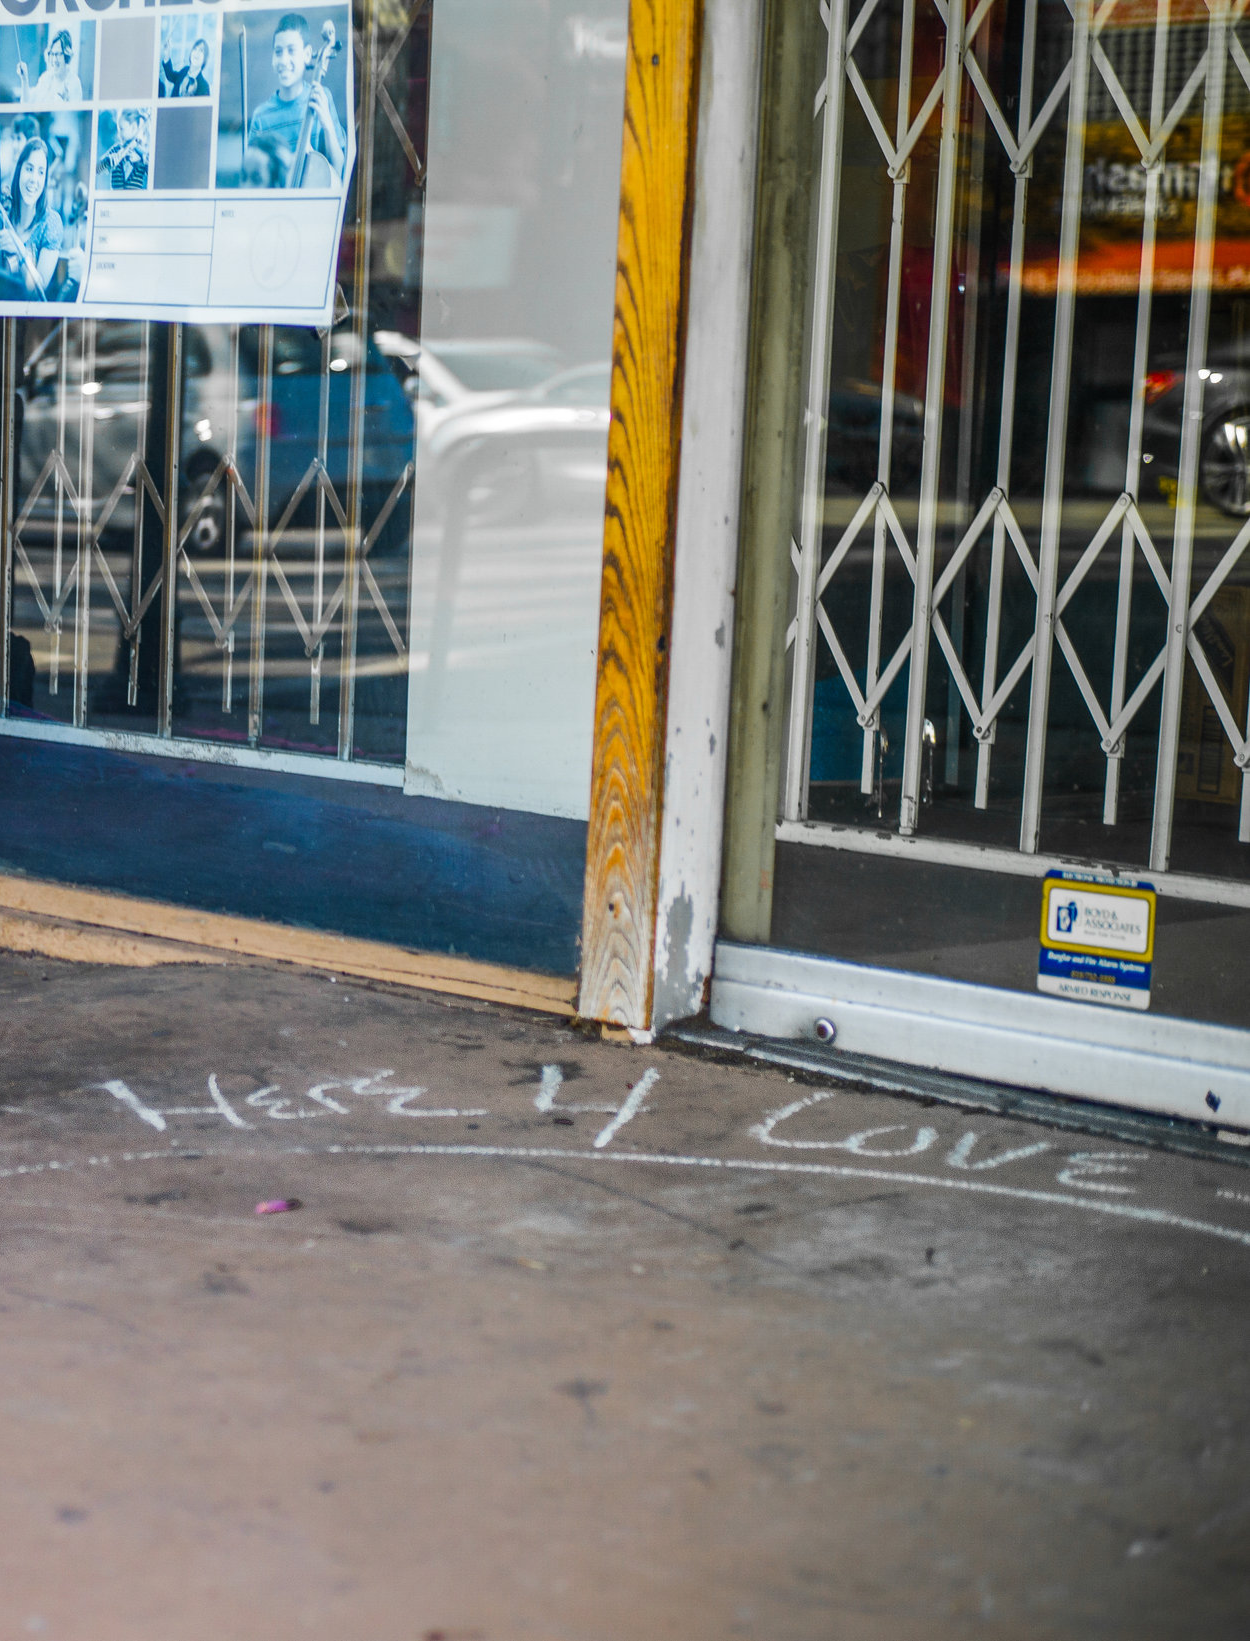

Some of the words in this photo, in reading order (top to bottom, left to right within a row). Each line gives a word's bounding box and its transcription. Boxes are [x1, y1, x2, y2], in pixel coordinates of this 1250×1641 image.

[1084, 918, 1142, 936] ASSOCIATES
[1047, 950, 1072, 964] Burglar
[1072, 955, 1085, 964] and
[1097, 958, 1119, 969] Alarm
[1119, 961, 1146, 974] Systems
[1058, 983, 1088, 996] ARMED
[1089, 987, 1132, 1002] RESPONSE
[533, 1064, 660, 1148] 4
[750, 1091, 1150, 1194] LOVE
